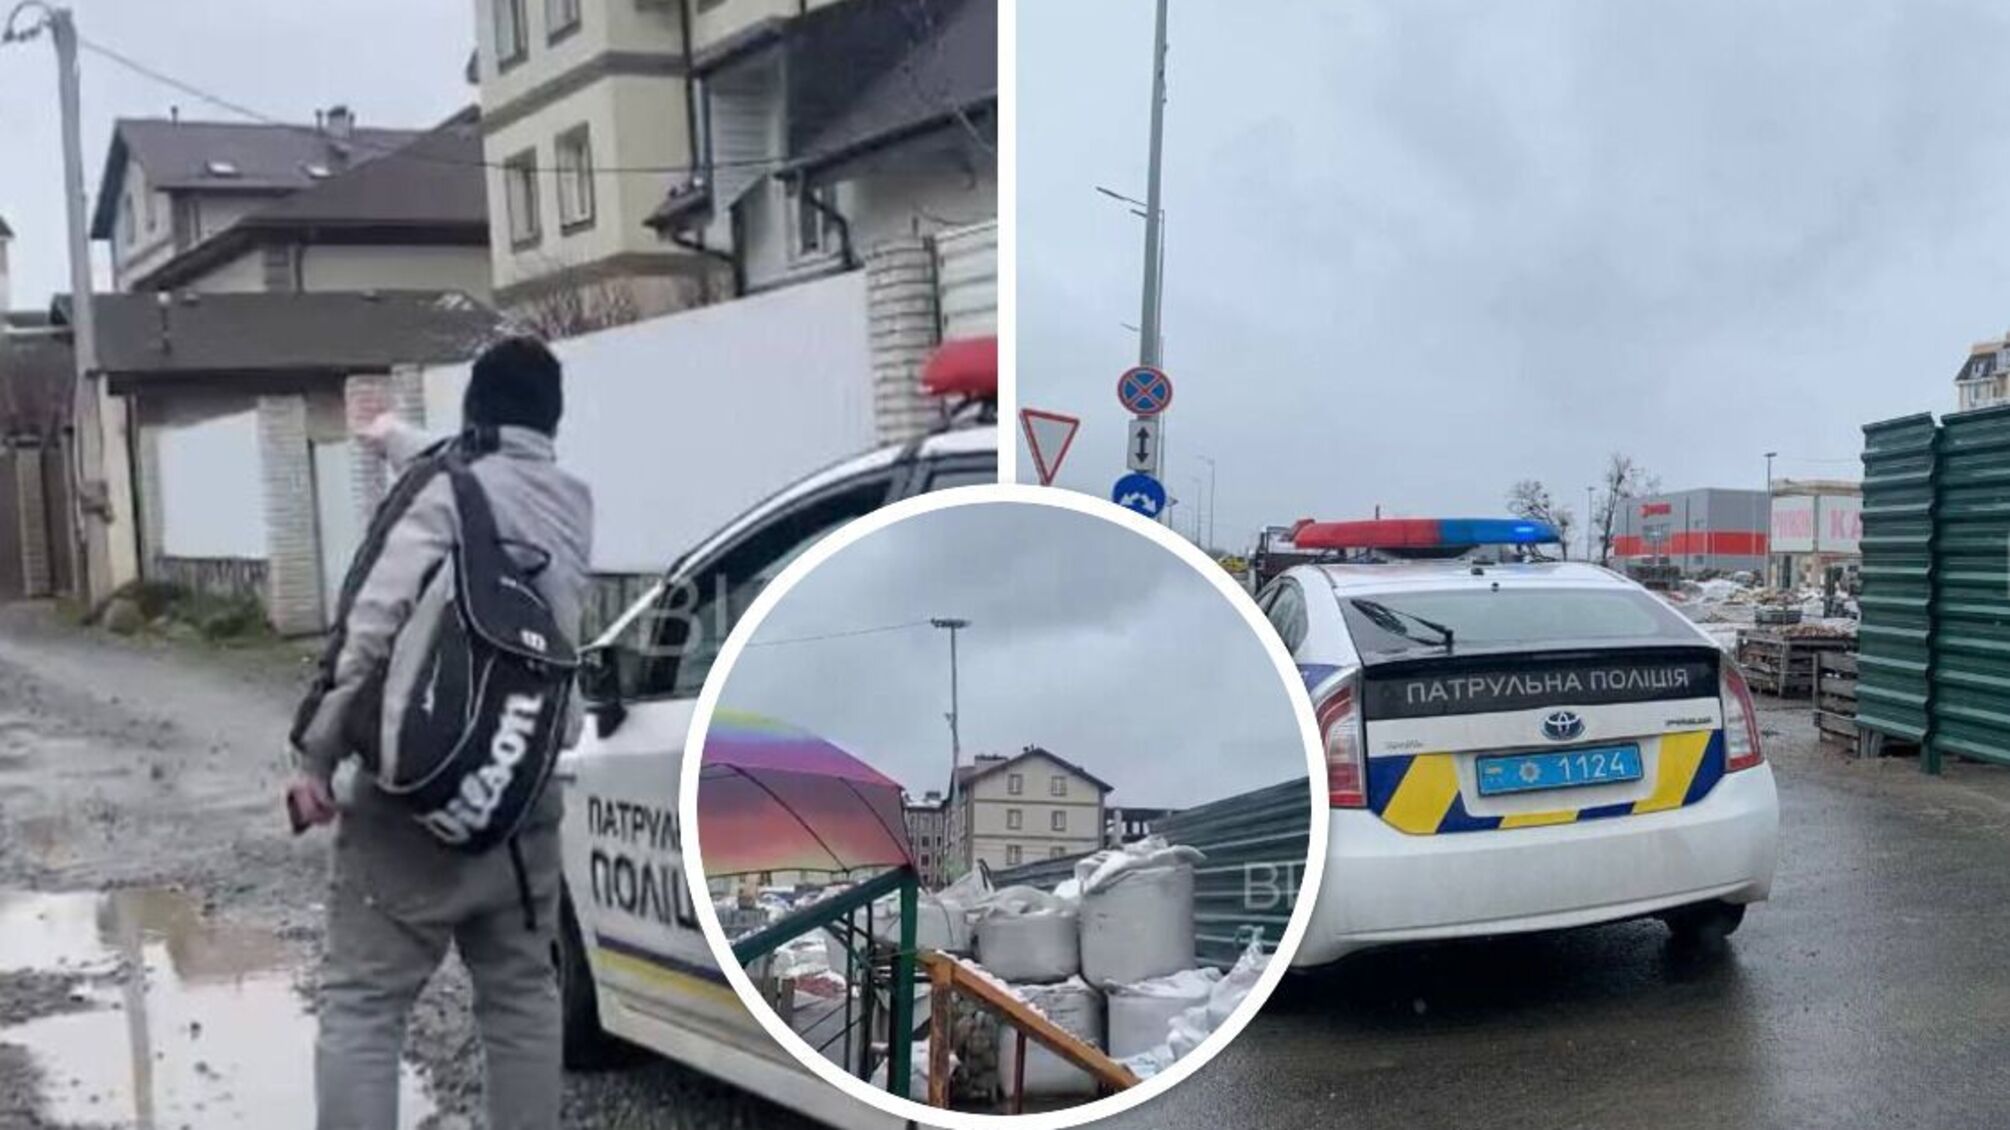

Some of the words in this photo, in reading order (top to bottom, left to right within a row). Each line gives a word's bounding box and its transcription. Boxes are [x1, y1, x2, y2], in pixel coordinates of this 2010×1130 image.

[1406, 675, 1582, 704] ПАТРУЛЬНА
[1590, 668, 1690, 690] ПОЛІЦІЯ
[1556, 753, 1626, 781] 1124
